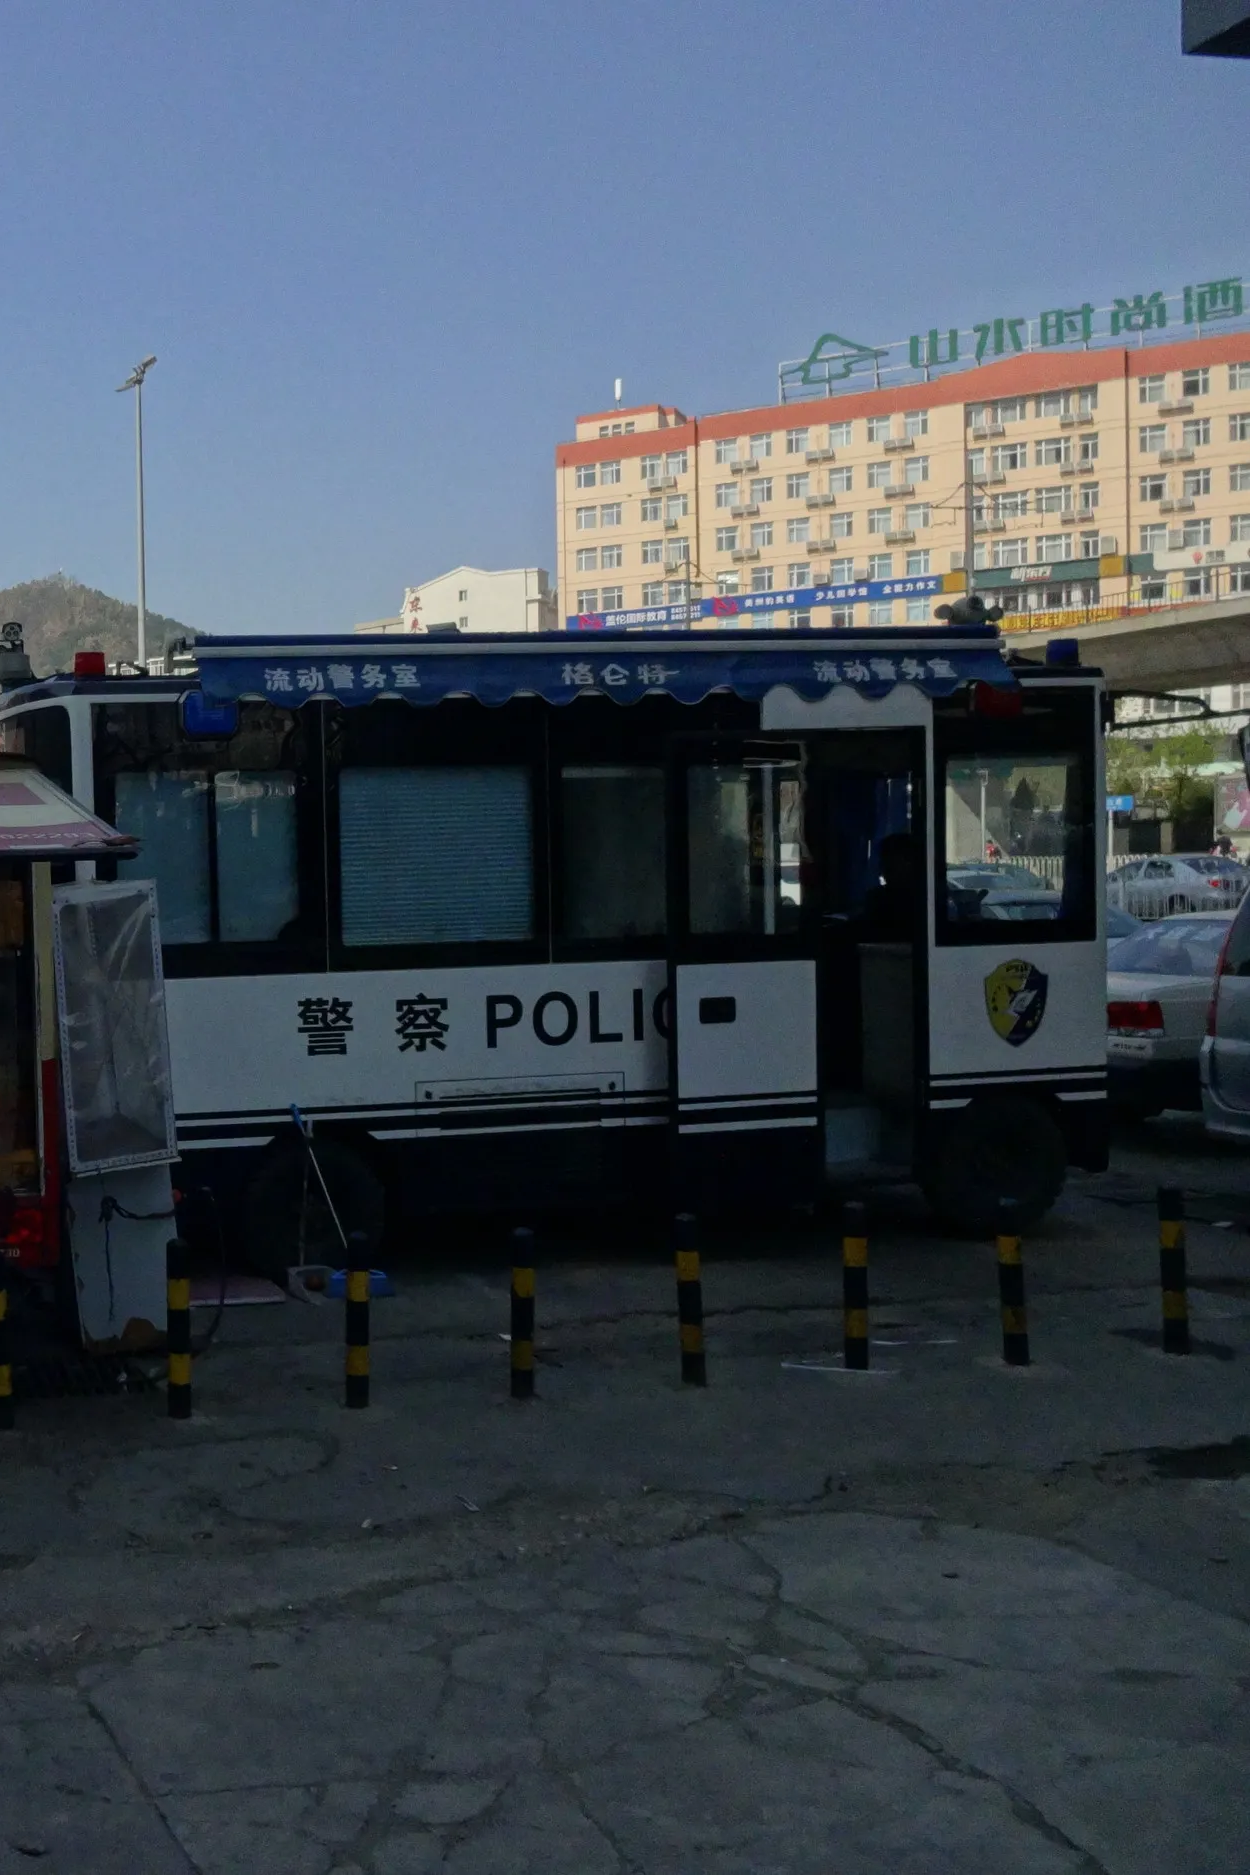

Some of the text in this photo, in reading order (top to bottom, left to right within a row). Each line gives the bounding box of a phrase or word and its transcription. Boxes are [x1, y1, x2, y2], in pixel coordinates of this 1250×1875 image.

[909, 276, 1243, 369] 山水时尚酒
[605, 610, 667, 627] 盖伦国际教育
[263, 664, 422, 692] 流动警务室
[813, 657, 958, 683] 流动警务室
[297, 993, 450, 1056] 警察
